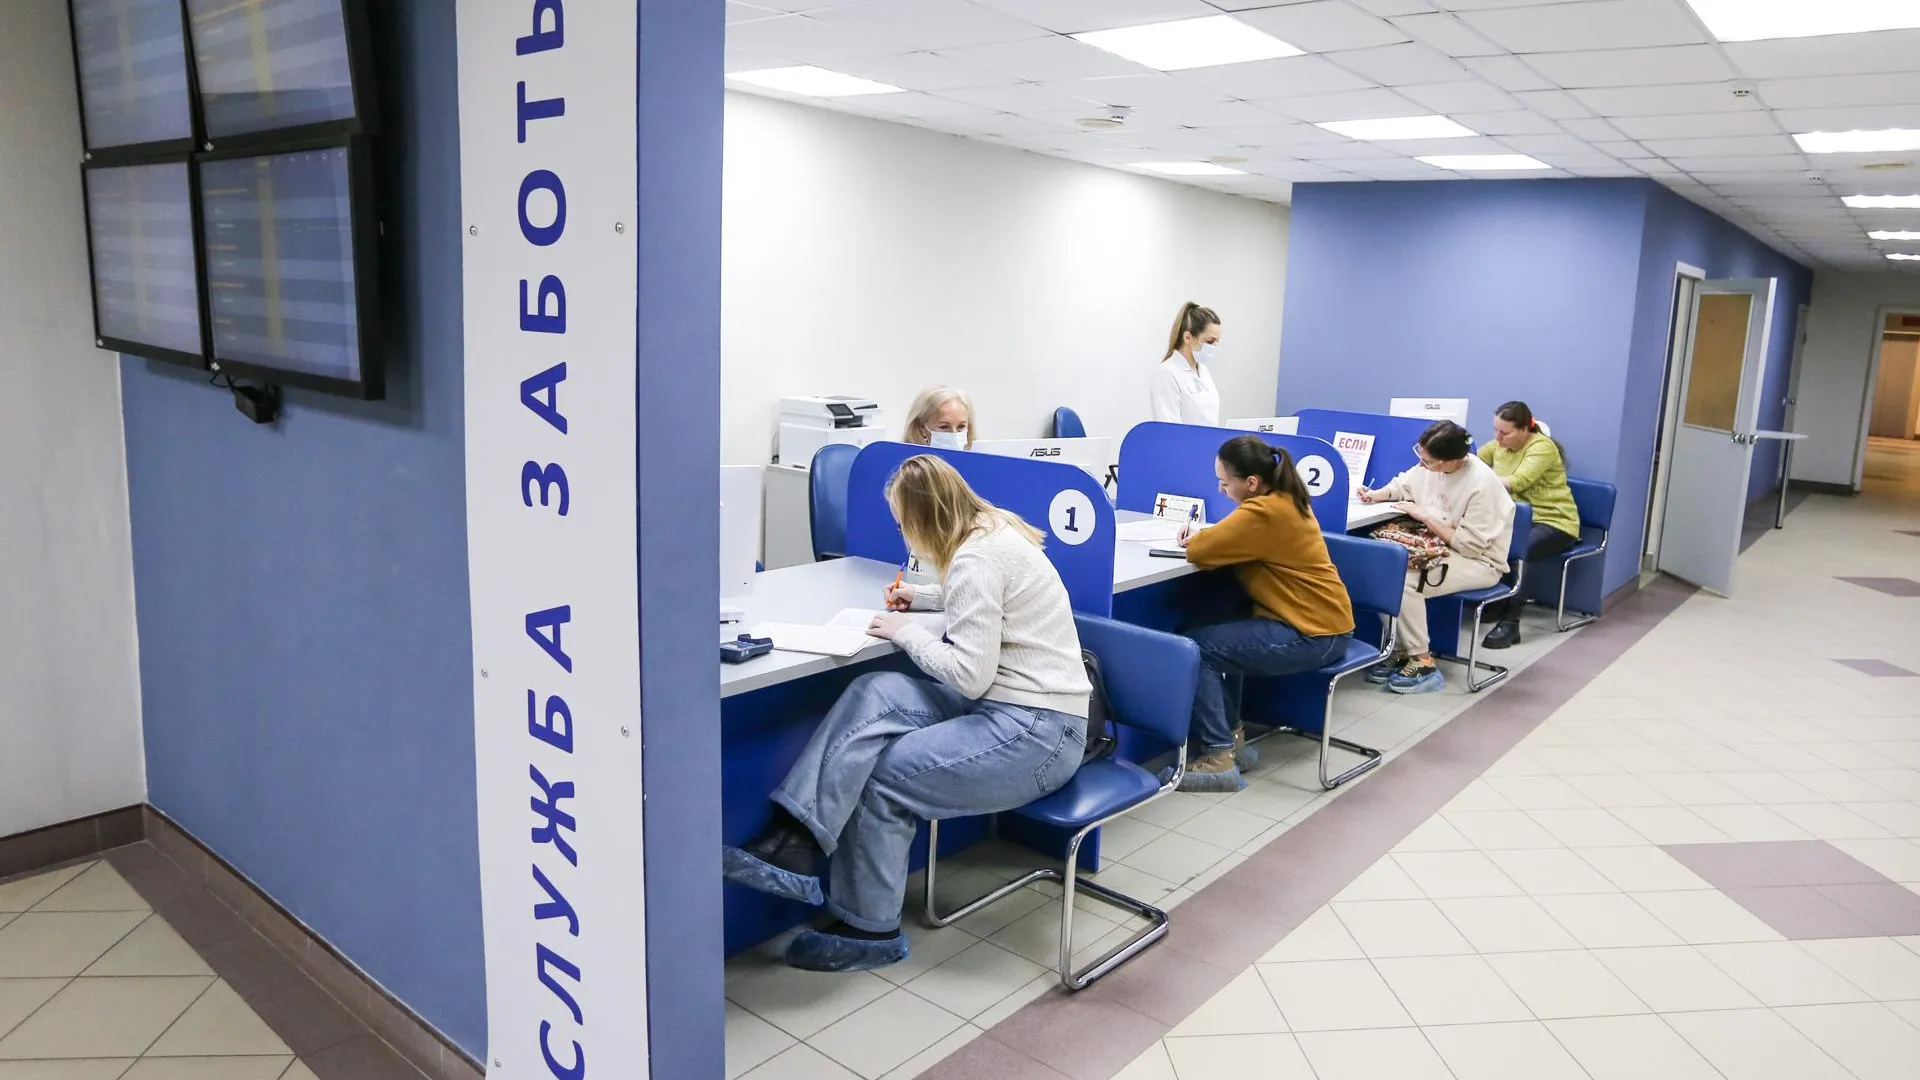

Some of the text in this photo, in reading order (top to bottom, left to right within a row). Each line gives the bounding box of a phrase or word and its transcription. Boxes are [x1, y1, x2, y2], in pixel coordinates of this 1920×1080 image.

[1030, 447, 1061, 457] ASUS
[1338, 437, 1368, 451] ЕСЛИ
[1307, 467, 1320, 487] 2
[1064, 506, 1079, 532] 1
[525, 604, 585, 1080] СЛУЖБА
